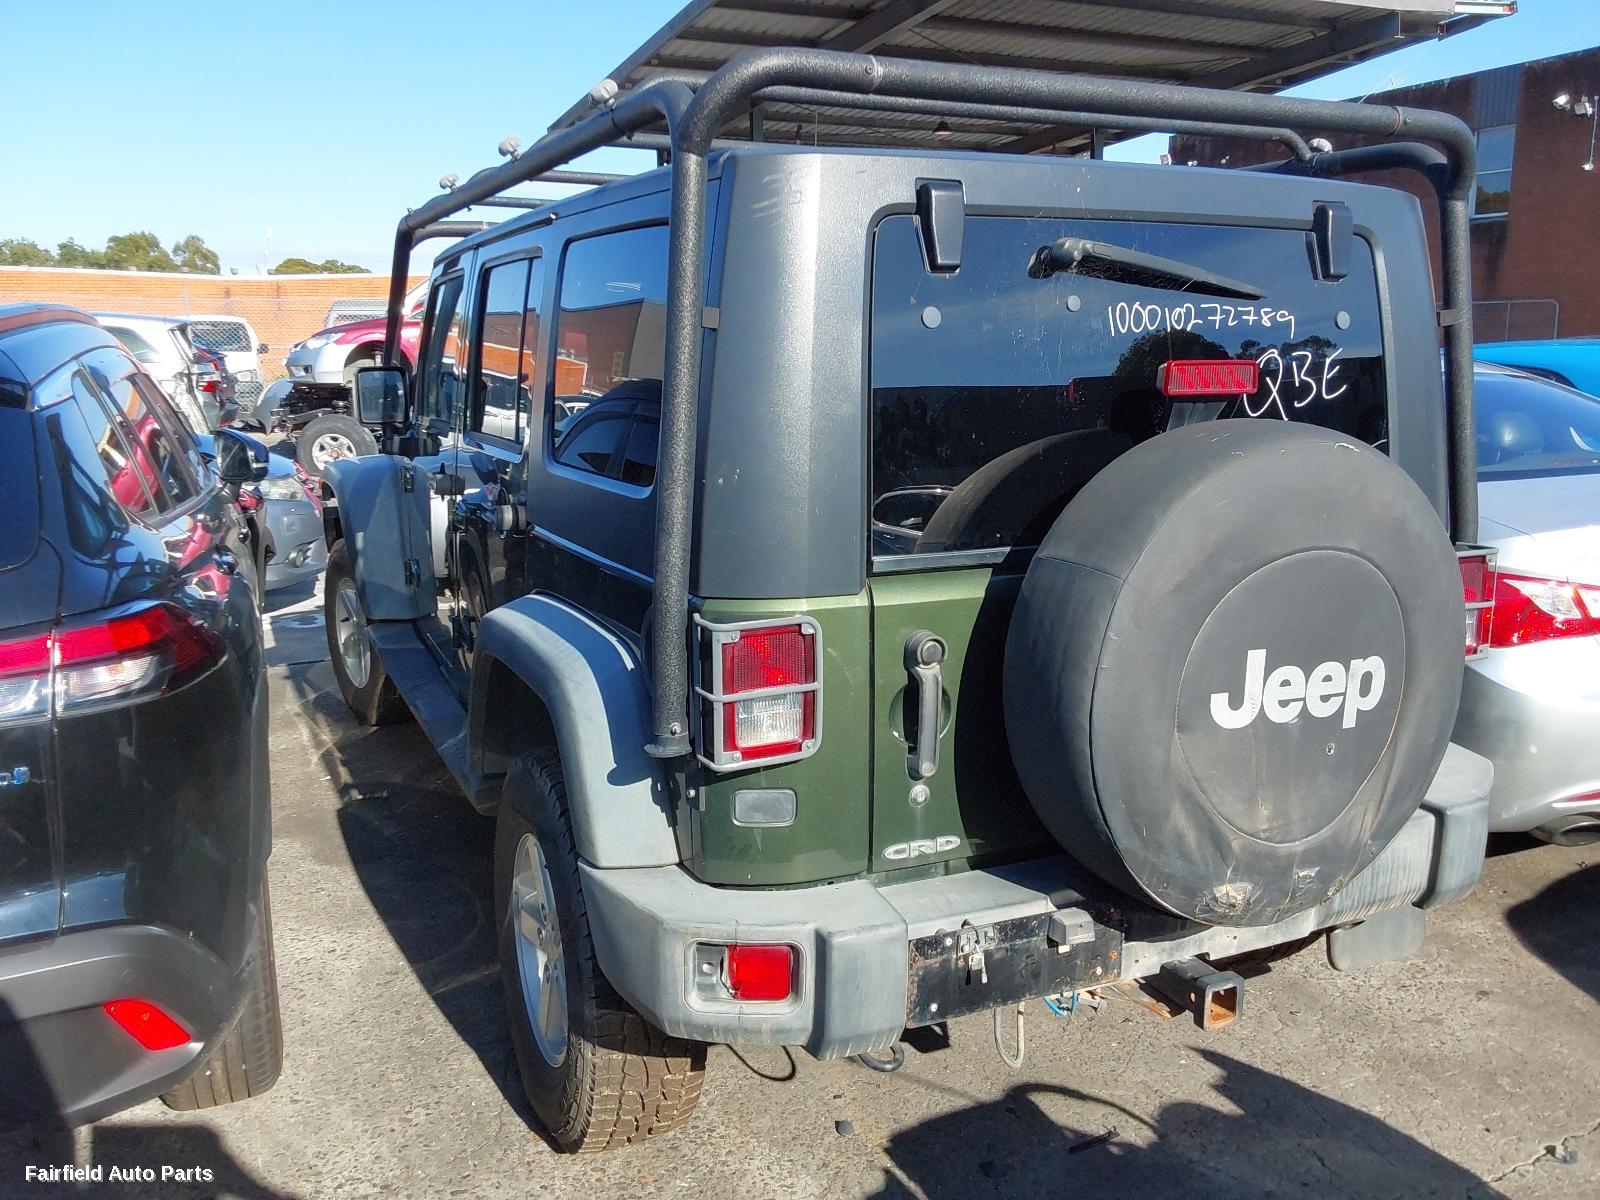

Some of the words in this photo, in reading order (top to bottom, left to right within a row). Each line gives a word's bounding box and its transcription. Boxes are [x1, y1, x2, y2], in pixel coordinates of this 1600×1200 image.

[1243, 347, 1348, 422] QBE
[1209, 648, 1387, 730] Jeep
[882, 835, 961, 860] CRD
